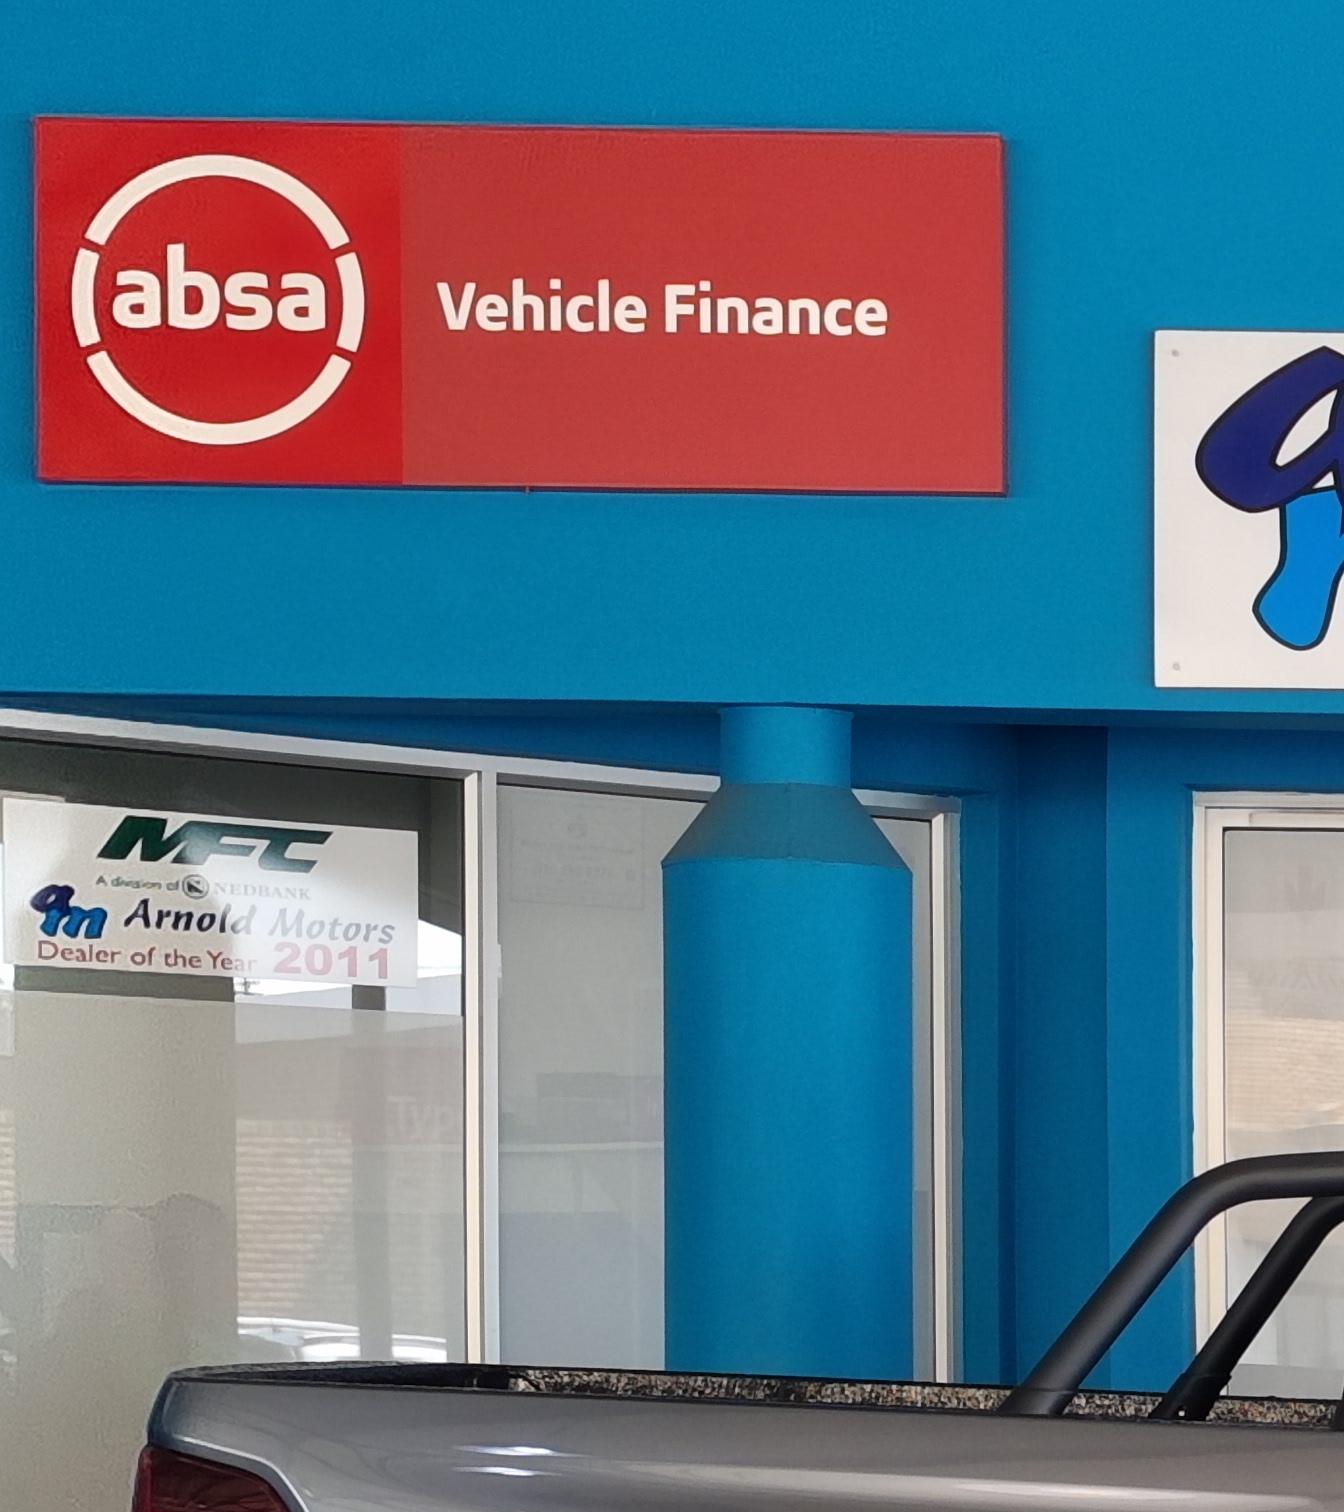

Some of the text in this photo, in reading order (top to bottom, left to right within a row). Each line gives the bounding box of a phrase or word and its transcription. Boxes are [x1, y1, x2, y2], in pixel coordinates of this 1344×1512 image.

[111, 242, 327, 330] absa
[436, 279, 889, 336] Vehicle Finance
[97, 815, 333, 873] MFC
[213, 881, 312, 900] NEDBANK
[124, 898, 396, 945] Arnold Motors
[37, 940, 389, 980] Dealer of the Year 2011
